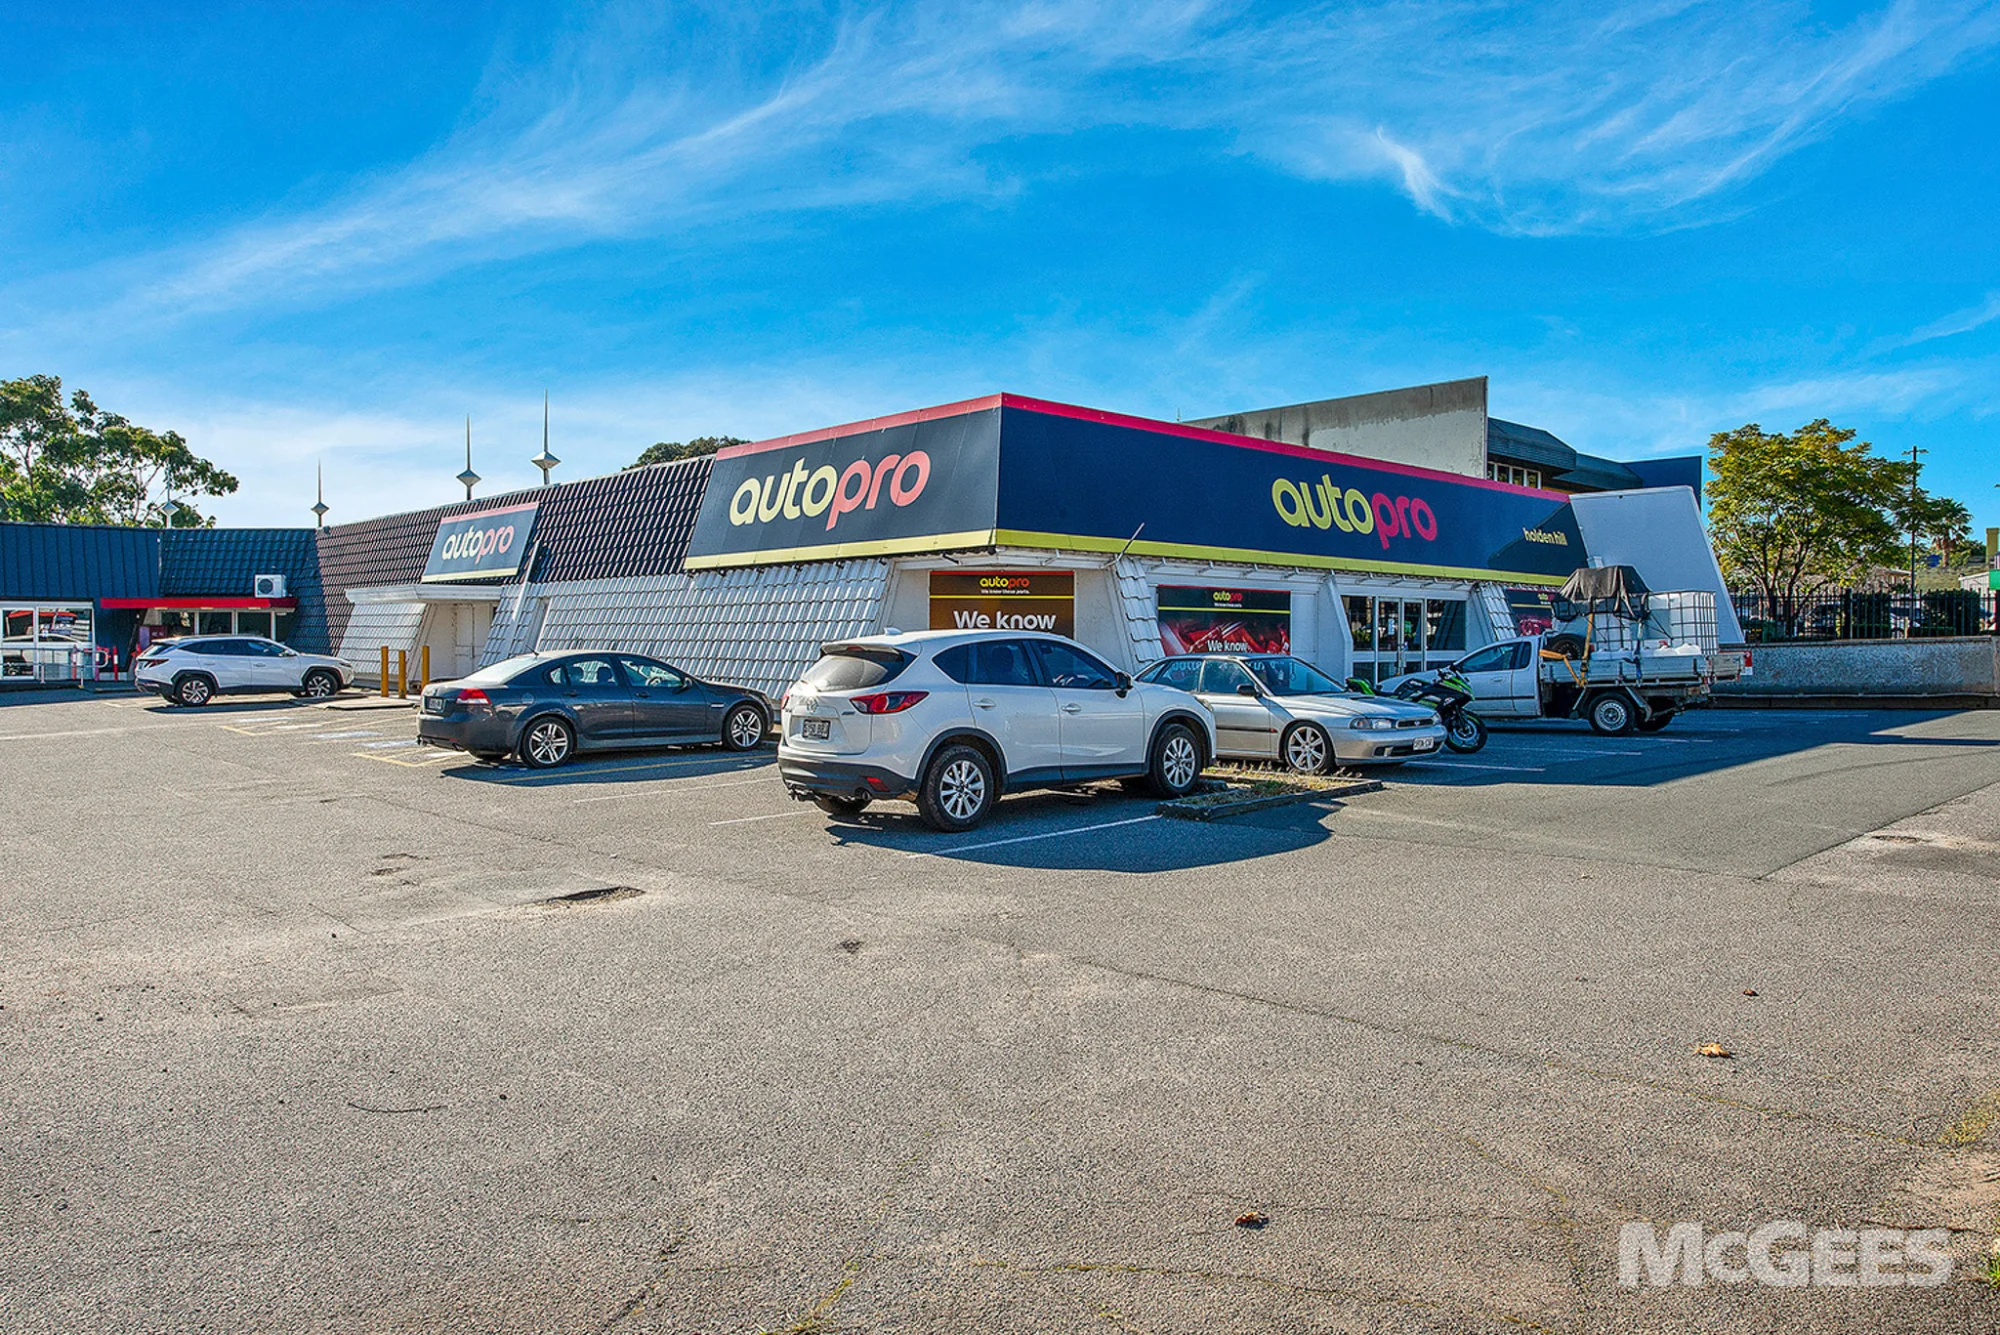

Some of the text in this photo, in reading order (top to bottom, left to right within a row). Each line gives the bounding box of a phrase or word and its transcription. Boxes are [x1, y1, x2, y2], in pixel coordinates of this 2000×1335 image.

[729, 450, 931, 531] autopro
[1271, 474, 1438, 550] autopro
[442, 525, 515, 565] autopro
[1522, 527, 1568, 546] holden hill
[979, 576, 1030, 589] autopro
[1212, 590, 1243, 603] autopro
[953, 610, 1057, 630] We know
[1207, 639, 1248, 652] We know
